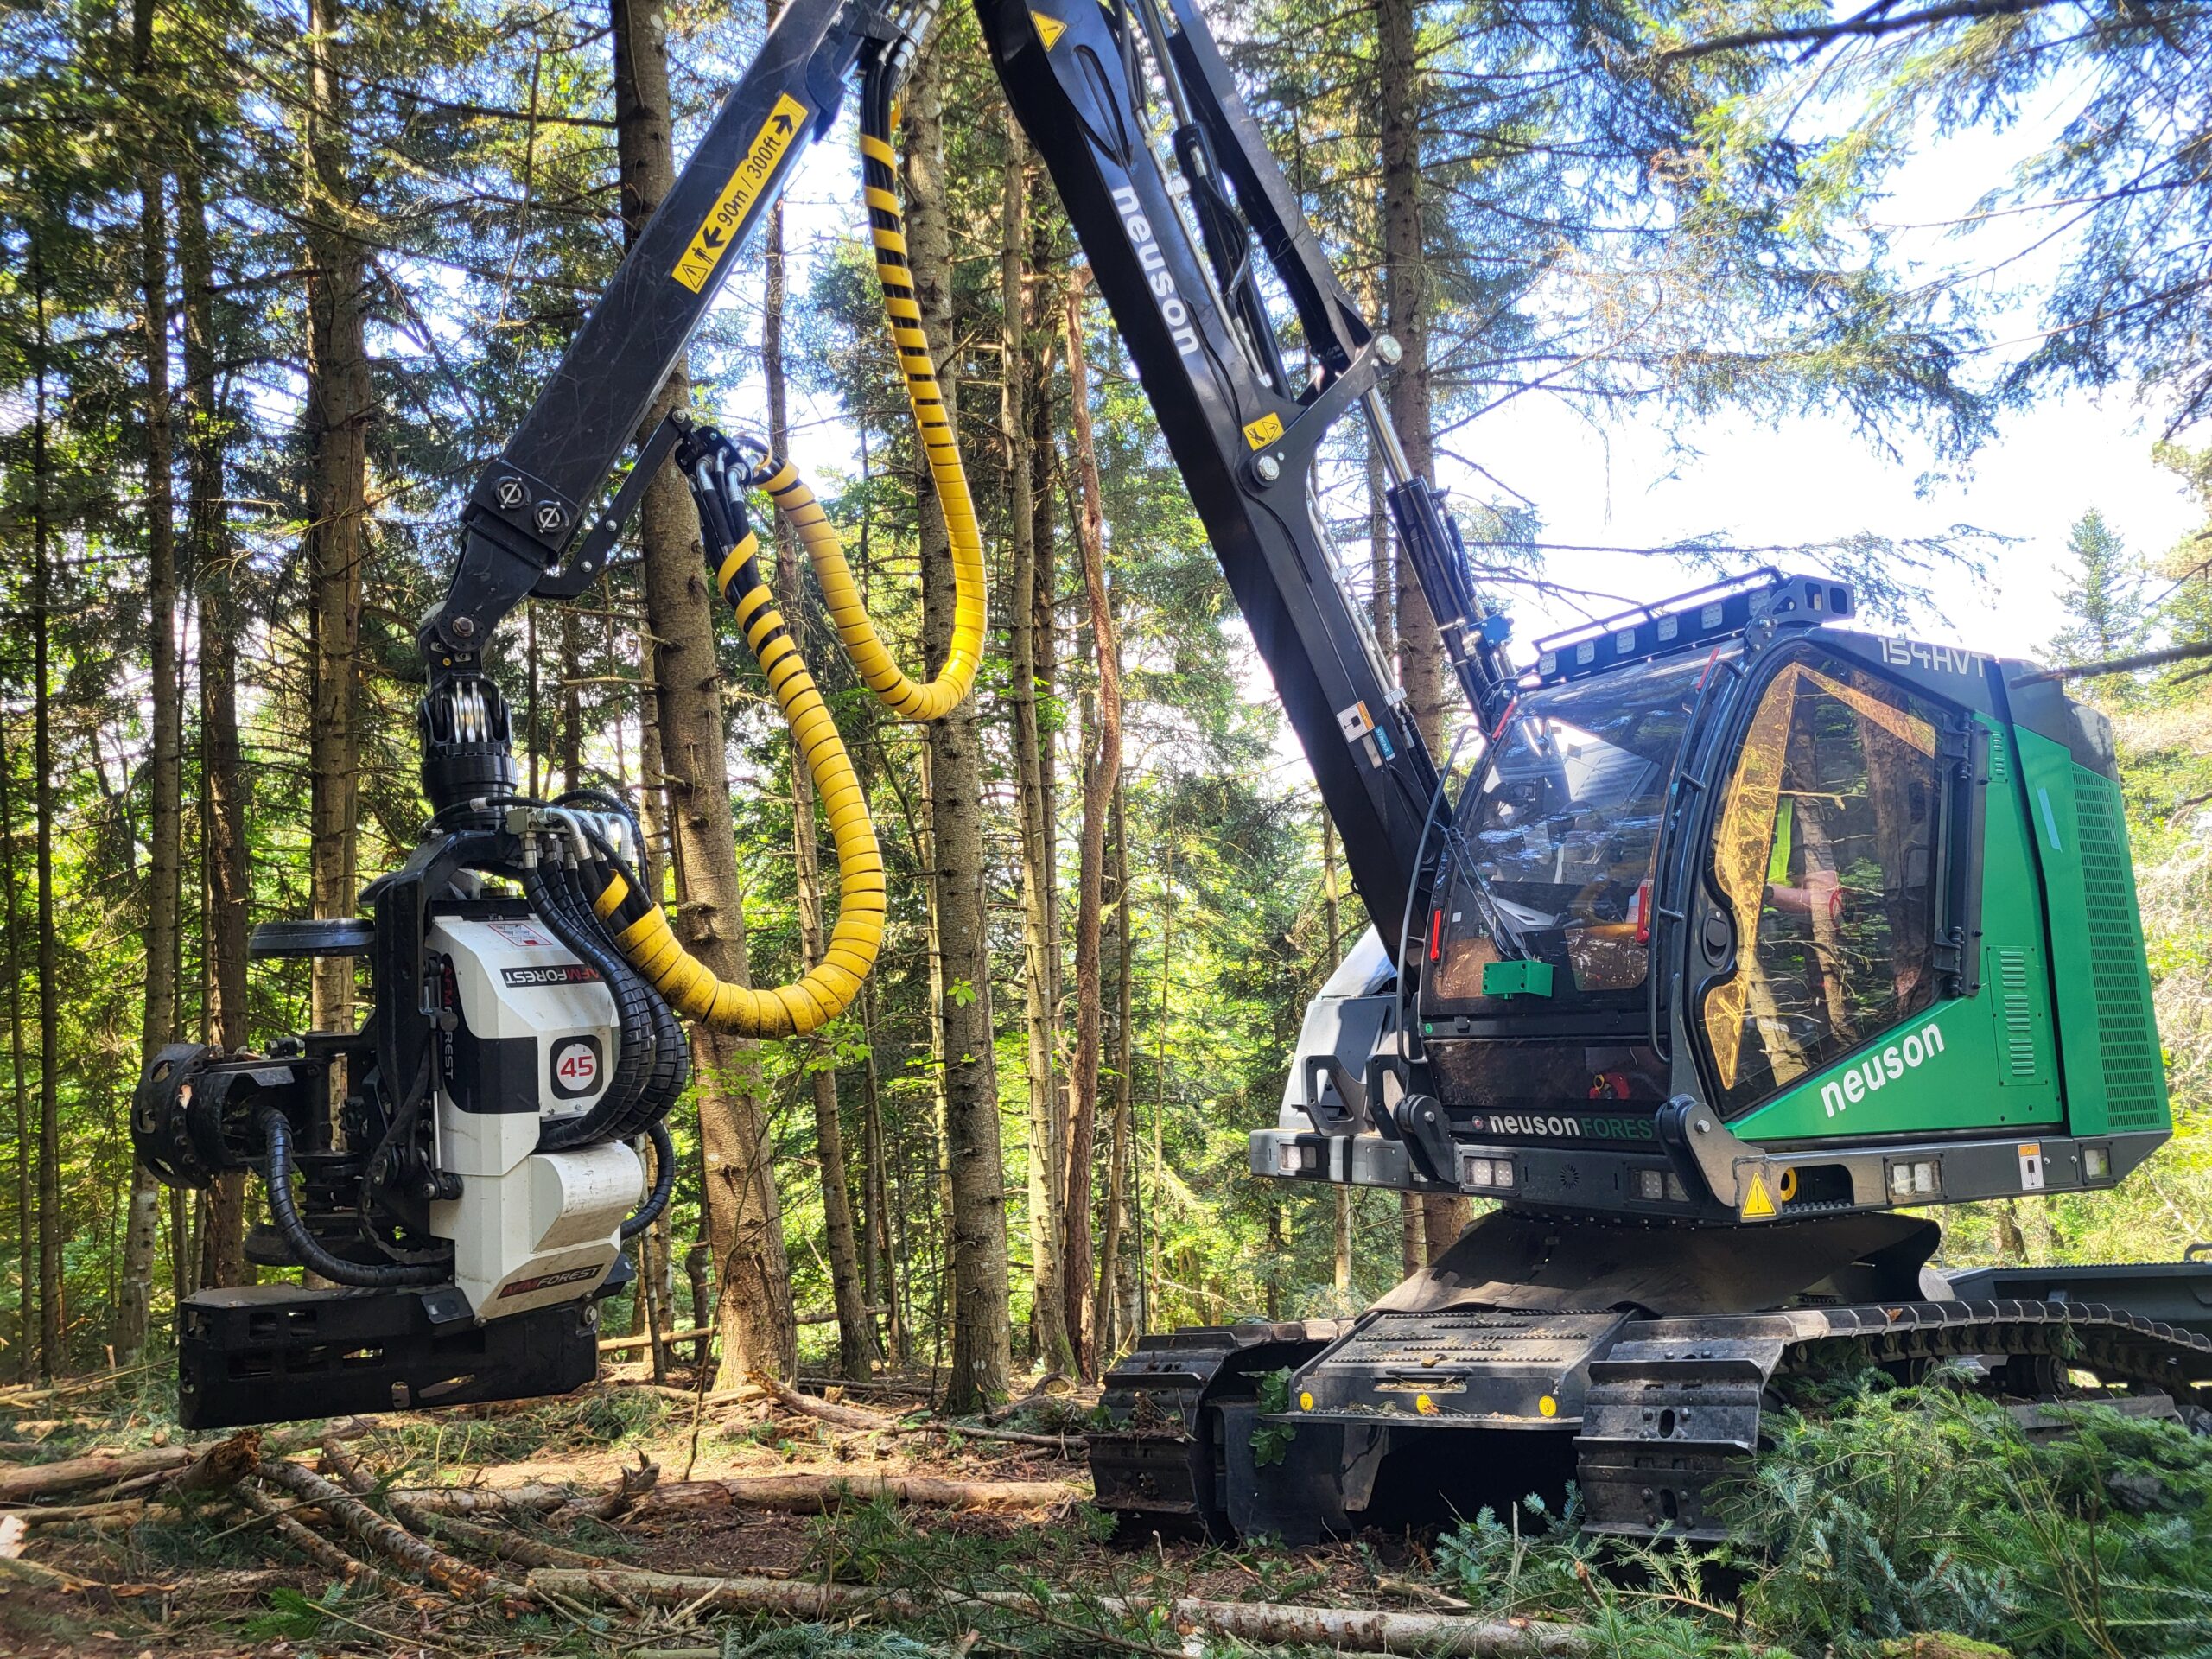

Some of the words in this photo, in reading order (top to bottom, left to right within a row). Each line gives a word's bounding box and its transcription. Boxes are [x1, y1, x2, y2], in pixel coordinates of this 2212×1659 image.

[717, 189, 750, 227] 90m
[746, 135, 782, 180] 300ft
[1111, 185, 1199, 356] neuson
[1877, 636, 1988, 677] 154HVT
[444, 967, 454, 1080] AFMFREST
[560, 1055, 594, 1077] 45
[1820, 1022, 1945, 1118] neuson
[1488, 1114, 1580, 1137] neuson
[1580, 1116, 1656, 1141] FORES
